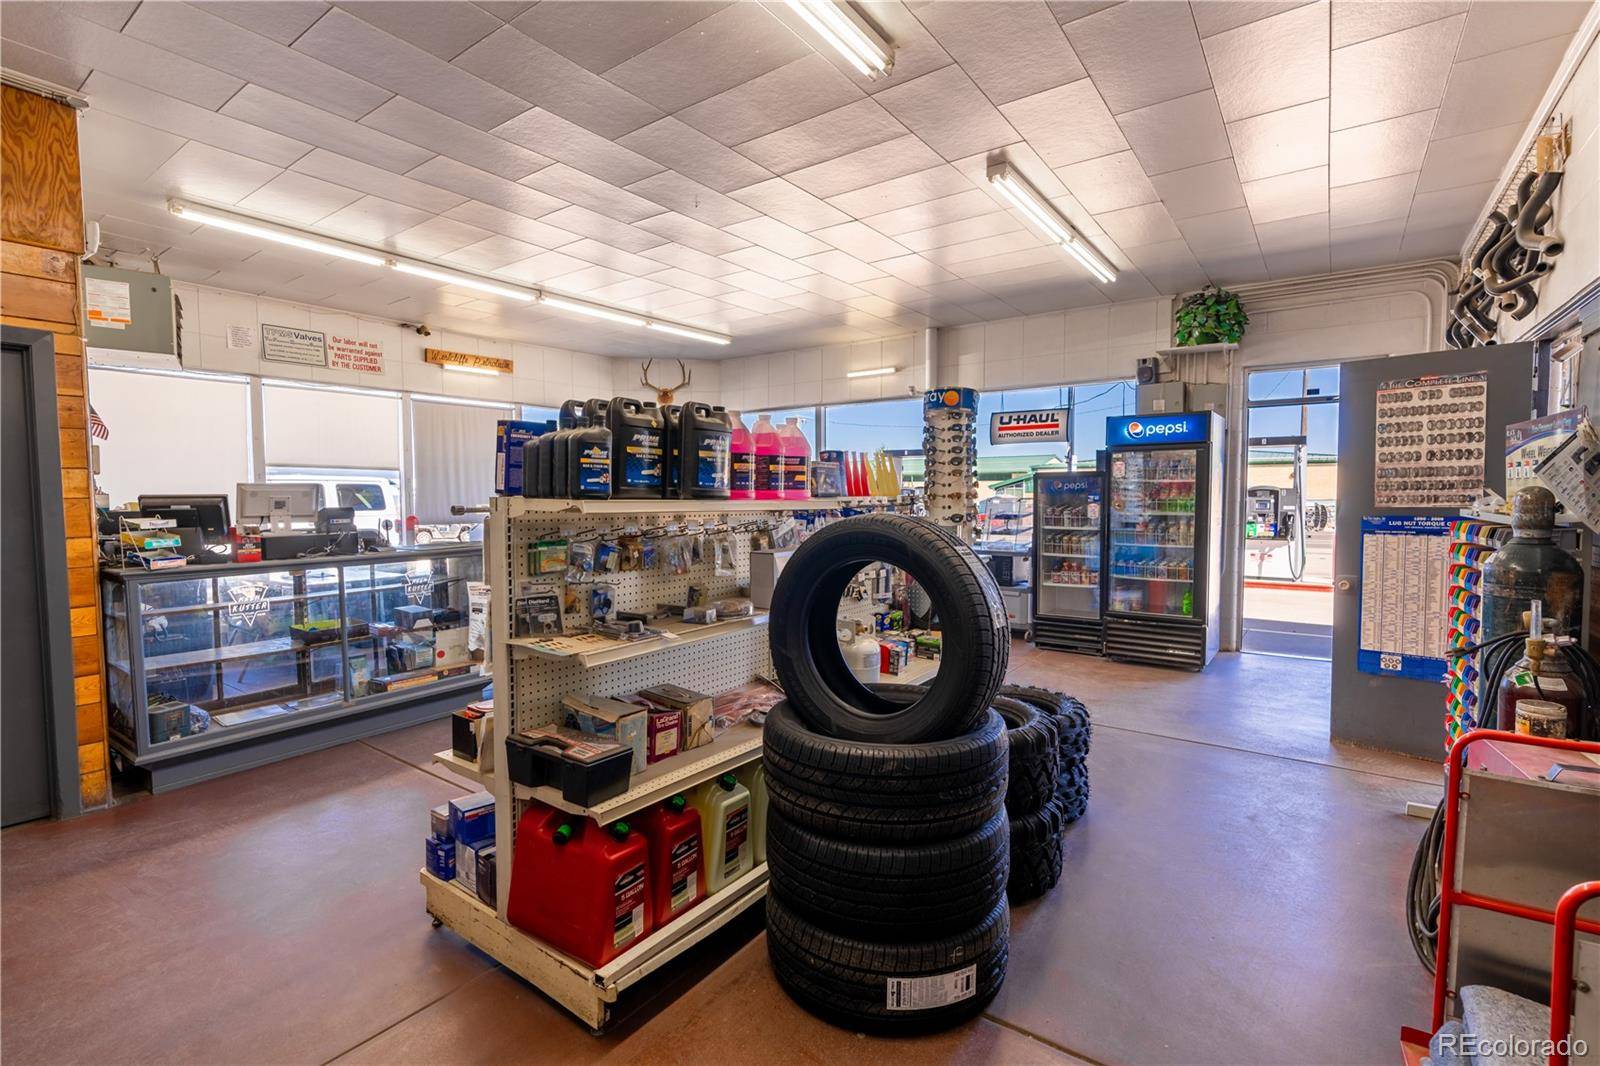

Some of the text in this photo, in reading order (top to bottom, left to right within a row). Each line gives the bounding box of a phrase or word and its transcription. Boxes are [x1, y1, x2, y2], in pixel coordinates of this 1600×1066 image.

[293, 331, 323, 343] Valves
[333, 335, 342, 344] Our
[344, 338, 356, 346] labor
[328, 343, 383, 358] be warranted against
[334, 352, 378, 364] PARTS SUPPLIED
[332, 359, 382, 372] BY THE CUSTOMER
[999, 413, 1059, 426] U-HAUL
[998, 430, 1059, 439] AUTHORIZED DEALER
[1146, 420, 1187, 437] pepsi
[1064, 480, 1088, 491] pepsi
[232, 601, 267, 613] KUTTER
[626, 883, 644, 899] GALLON
